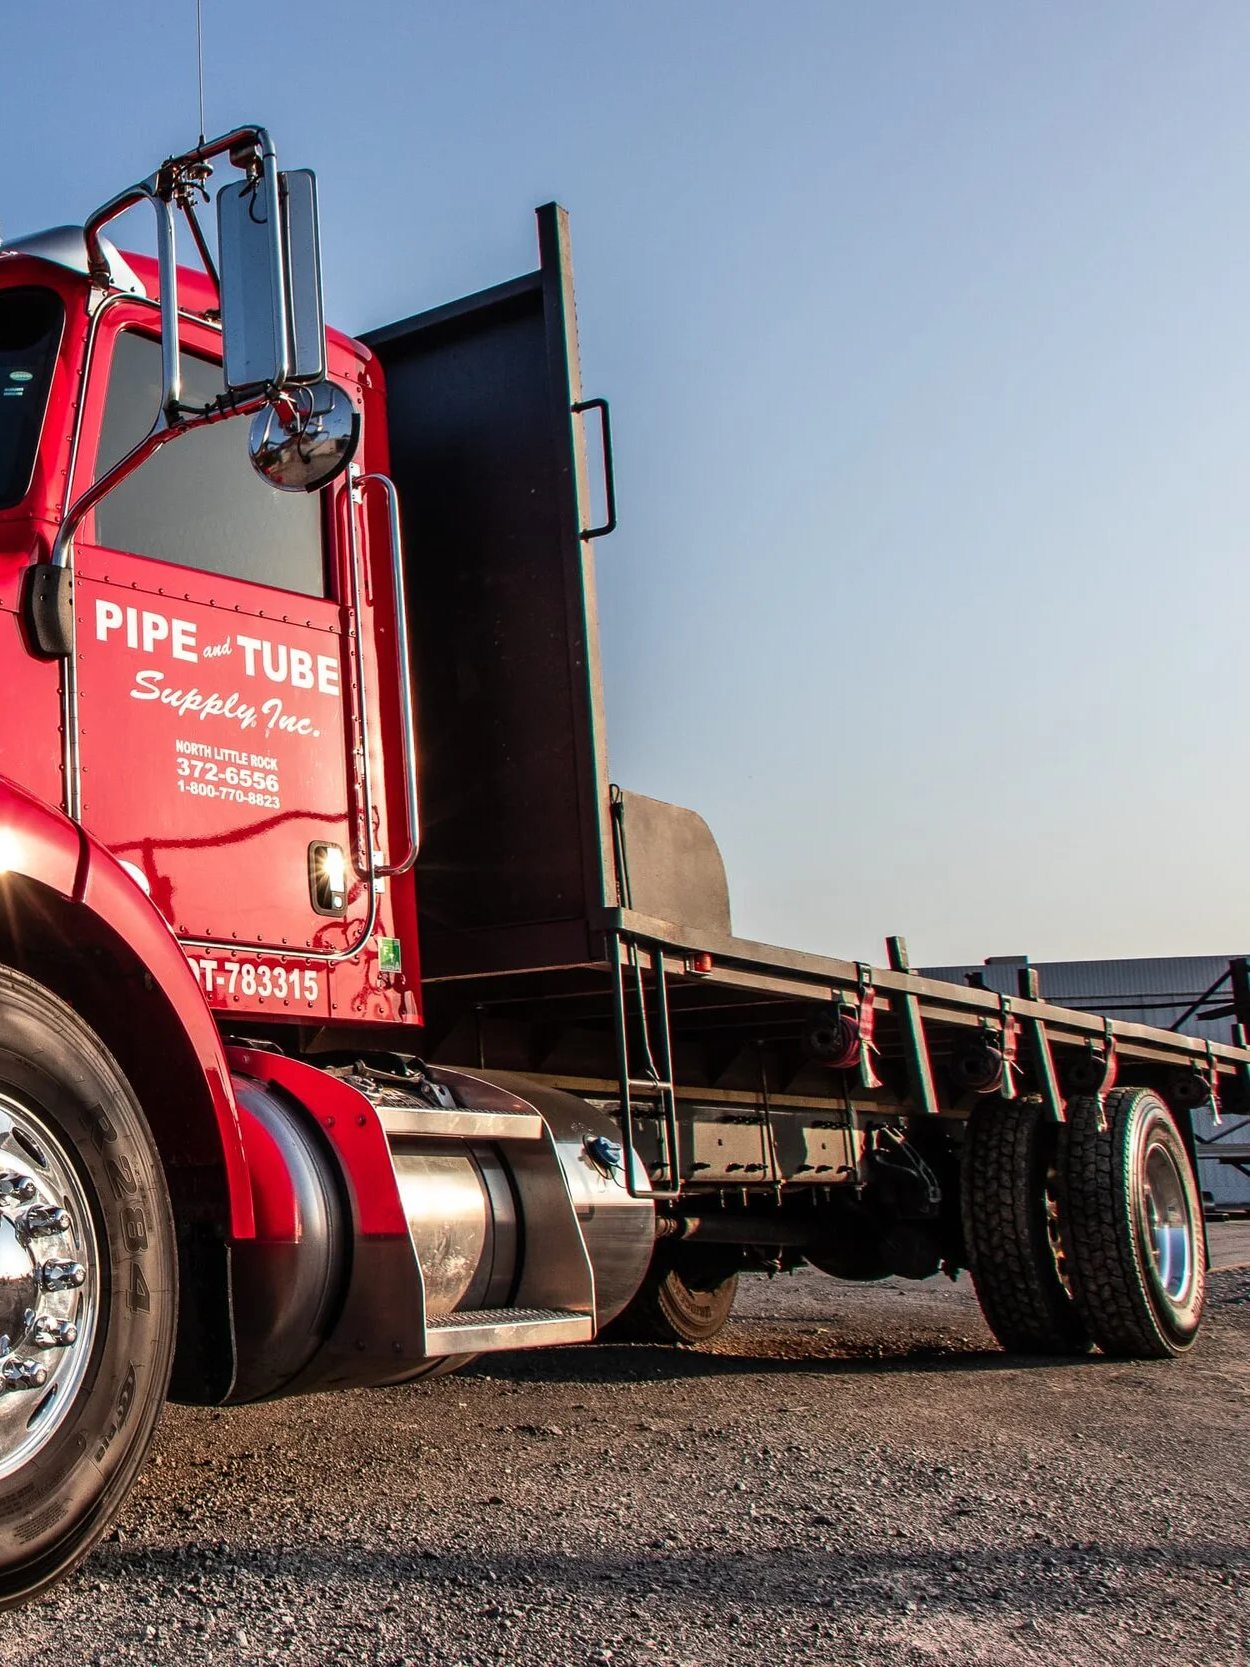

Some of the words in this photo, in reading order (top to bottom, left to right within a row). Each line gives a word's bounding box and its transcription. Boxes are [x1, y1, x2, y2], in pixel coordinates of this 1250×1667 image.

[95, 599, 198, 663] PIPE
[203, 636, 232, 659] and
[237, 635, 340, 696] TUBE
[261, 698, 321, 738] Inc.
[175, 739, 212, 759] NORTH
[214, 747, 249, 766] LITTLE
[250, 754, 278, 771] ROCK
[176, 757, 280, 792] 372-6556
[177, 779, 280, 809] 1-800-770-8823
